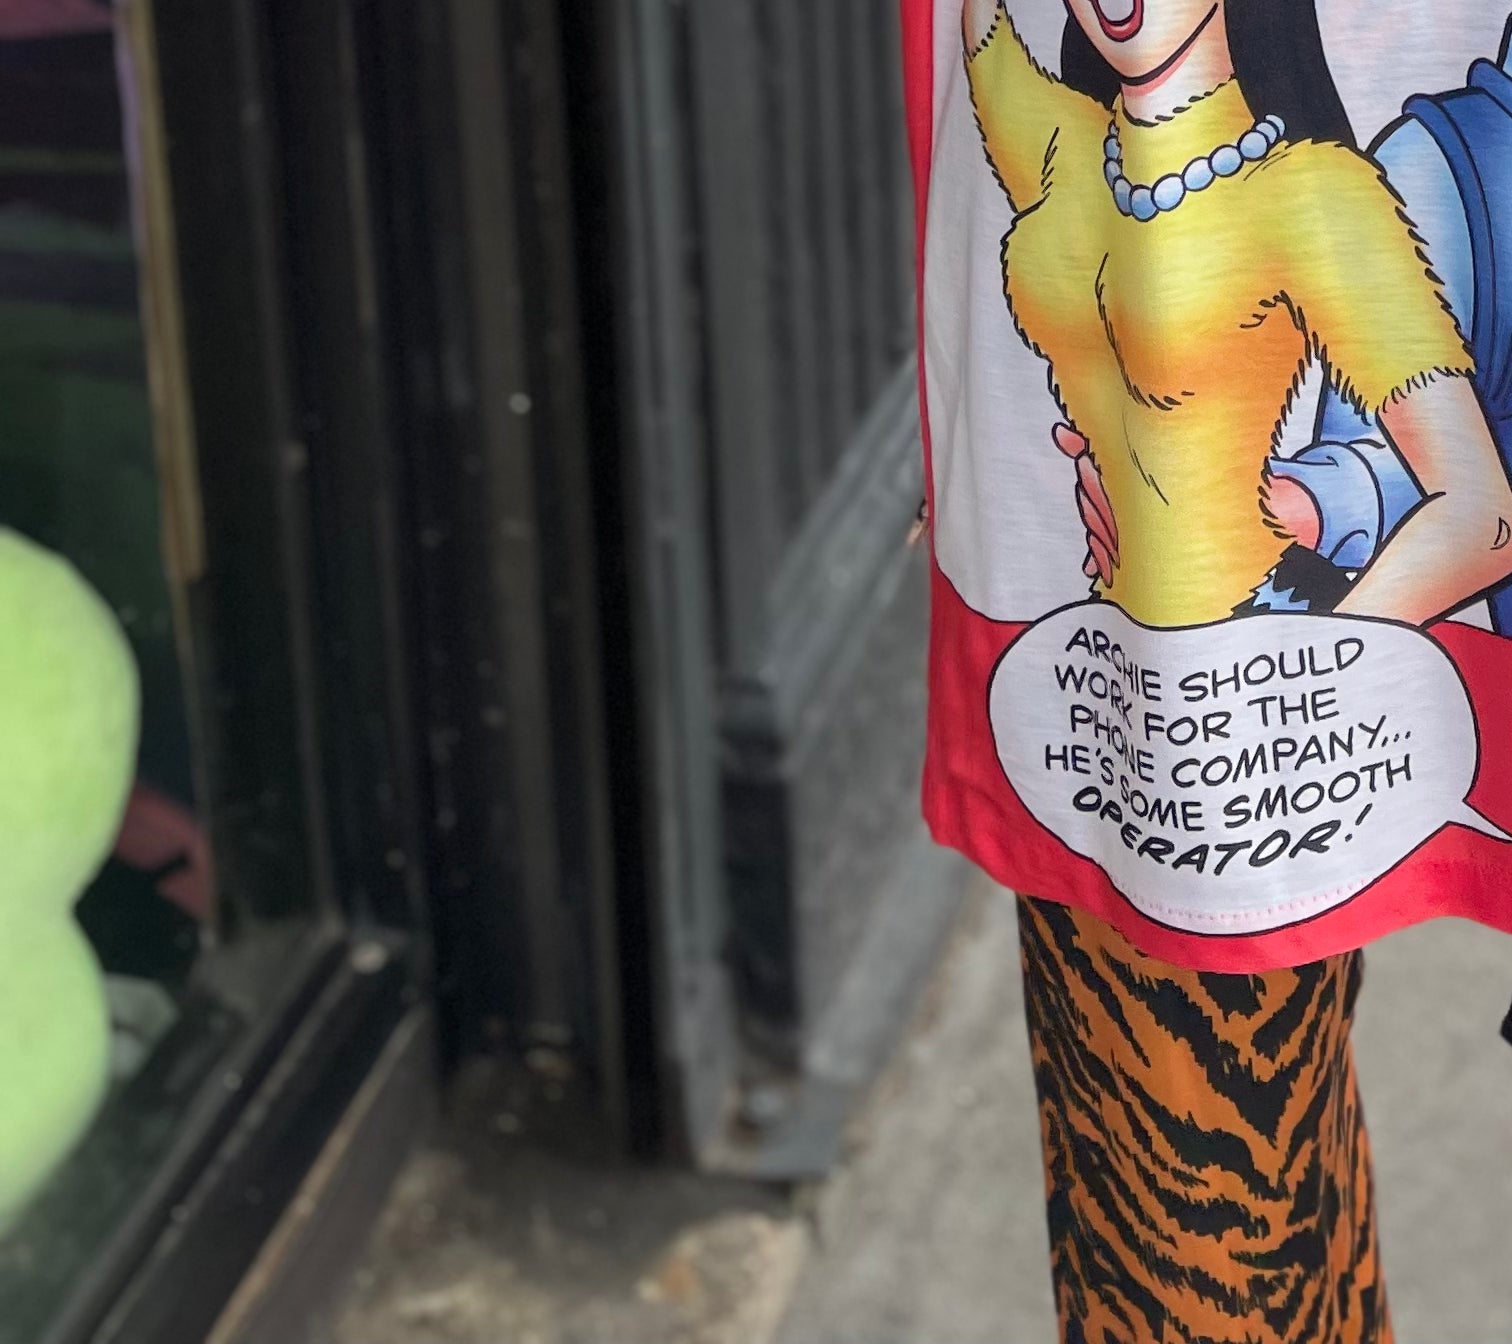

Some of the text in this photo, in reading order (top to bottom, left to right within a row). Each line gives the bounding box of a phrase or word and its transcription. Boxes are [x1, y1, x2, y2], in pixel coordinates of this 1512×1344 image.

[1054, 663, 1340, 746] WORK FOR THE
[1065, 627, 1365, 703] ARCHIE SHOULD
[1070, 703, 1155, 784] PHONE
[1045, 743, 1413, 833] HE'S SOME SMOOTH
[1072, 785, 1374, 876] OPERATOR!
